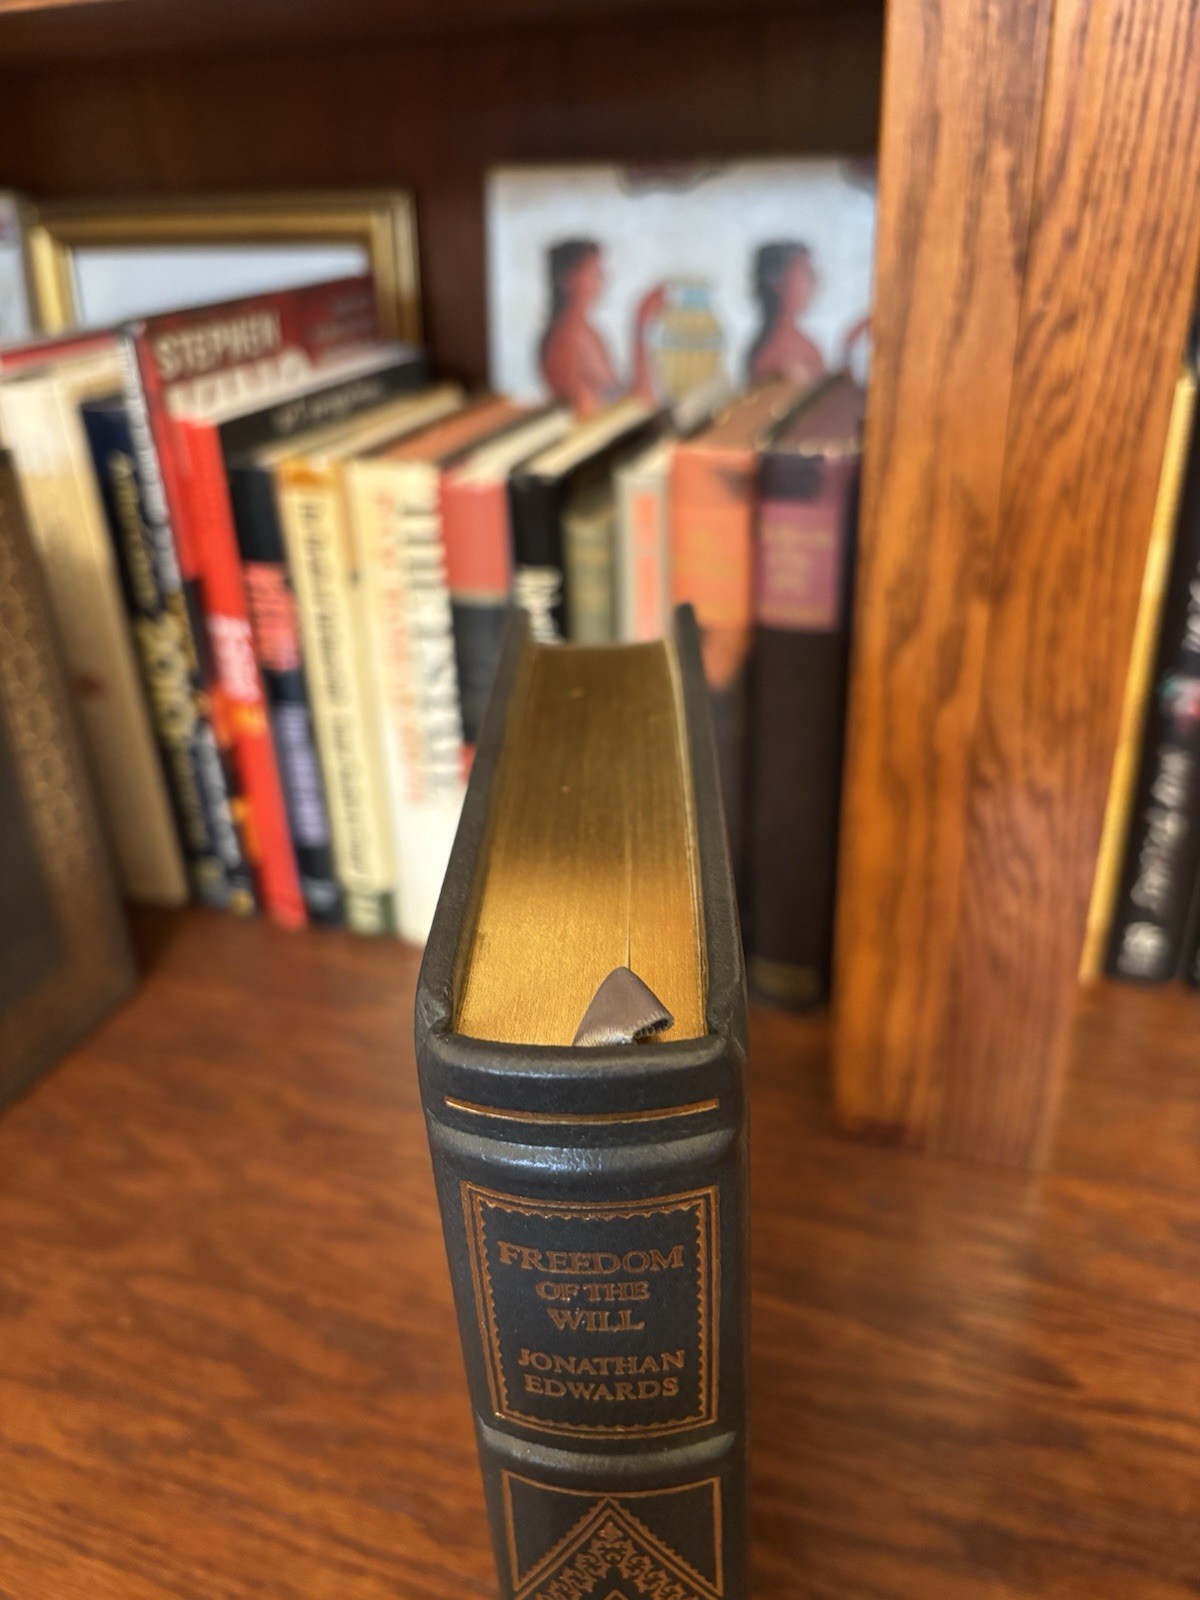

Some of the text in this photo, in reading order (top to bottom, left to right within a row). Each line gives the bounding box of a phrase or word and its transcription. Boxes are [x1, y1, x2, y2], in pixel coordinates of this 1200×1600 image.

[154, 311, 282, 380] STEPHEN
[497, 1240, 685, 1275] FREEDOM
[535, 1280, 650, 1302] OF THE
[546, 1308, 646, 1332] WILL
[517, 1348, 686, 1376] JONATHAN
[524, 1374, 681, 1401] EDWARDS
